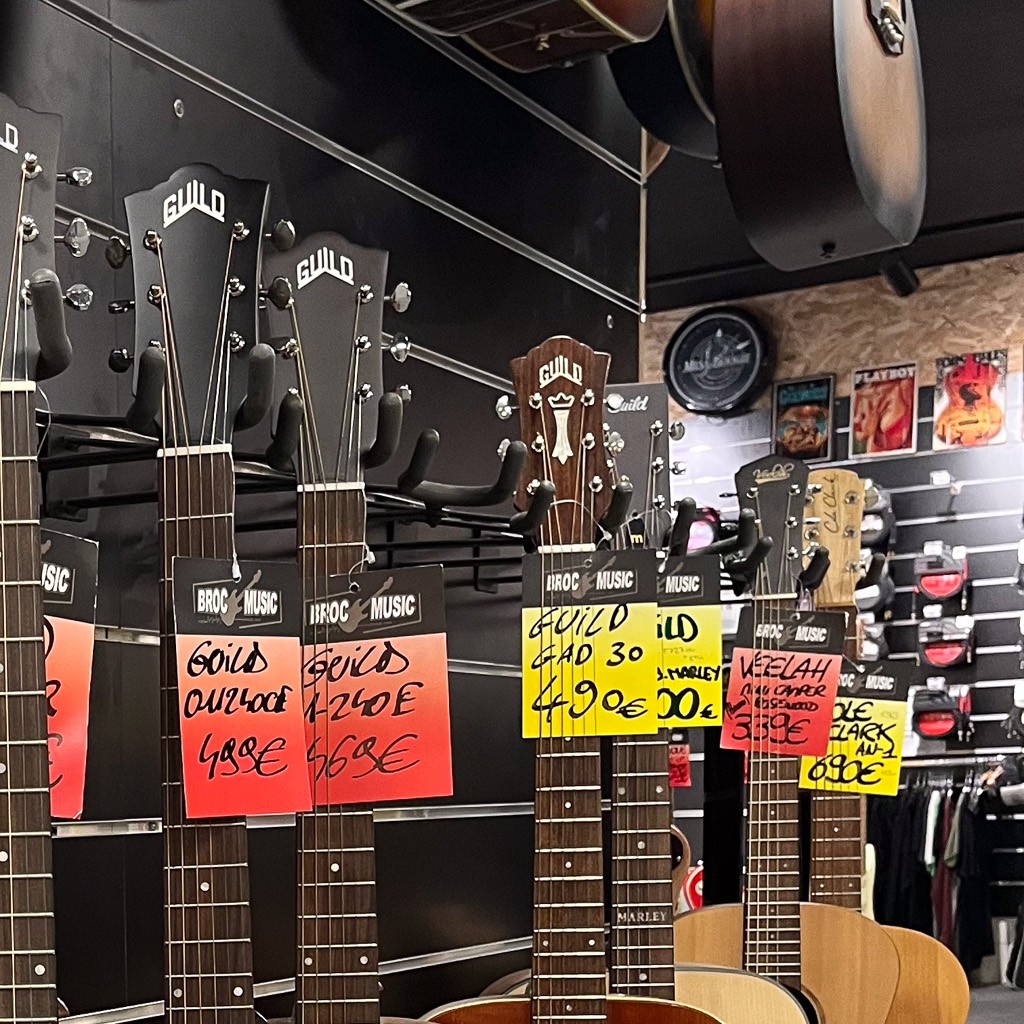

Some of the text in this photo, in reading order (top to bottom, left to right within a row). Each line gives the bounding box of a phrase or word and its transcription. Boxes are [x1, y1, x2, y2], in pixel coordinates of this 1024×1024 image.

[162, 179, 225, 229] GUILD
[296, 246, 355, 290] GUILD
[538, 354, 583, 389] GUILD
[42, 563, 71, 594] SIC
[547, 570, 635, 592] BROC MUSIC
[665, 575, 701, 594] MUSIC
[197, 587, 278, 616] BROC MUSIC
[310, 594, 416, 625] BROC MUSIC
[755, 623, 828, 642] BROC MUSIC
[531, 642, 593, 670] GAD
[606, 641, 644, 667] 30
[740, 651, 833, 683] VEELAH
[865, 674, 895, 691] MUSIC
[531, 675, 648, 723] 490€
[832, 700, 874, 722] OLE
[732, 713, 811, 745] 339€
[199, 733, 288, 780] 499€
[807, 754, 884, 785] 690€
[617, 911, 668, 923] MARLEY
